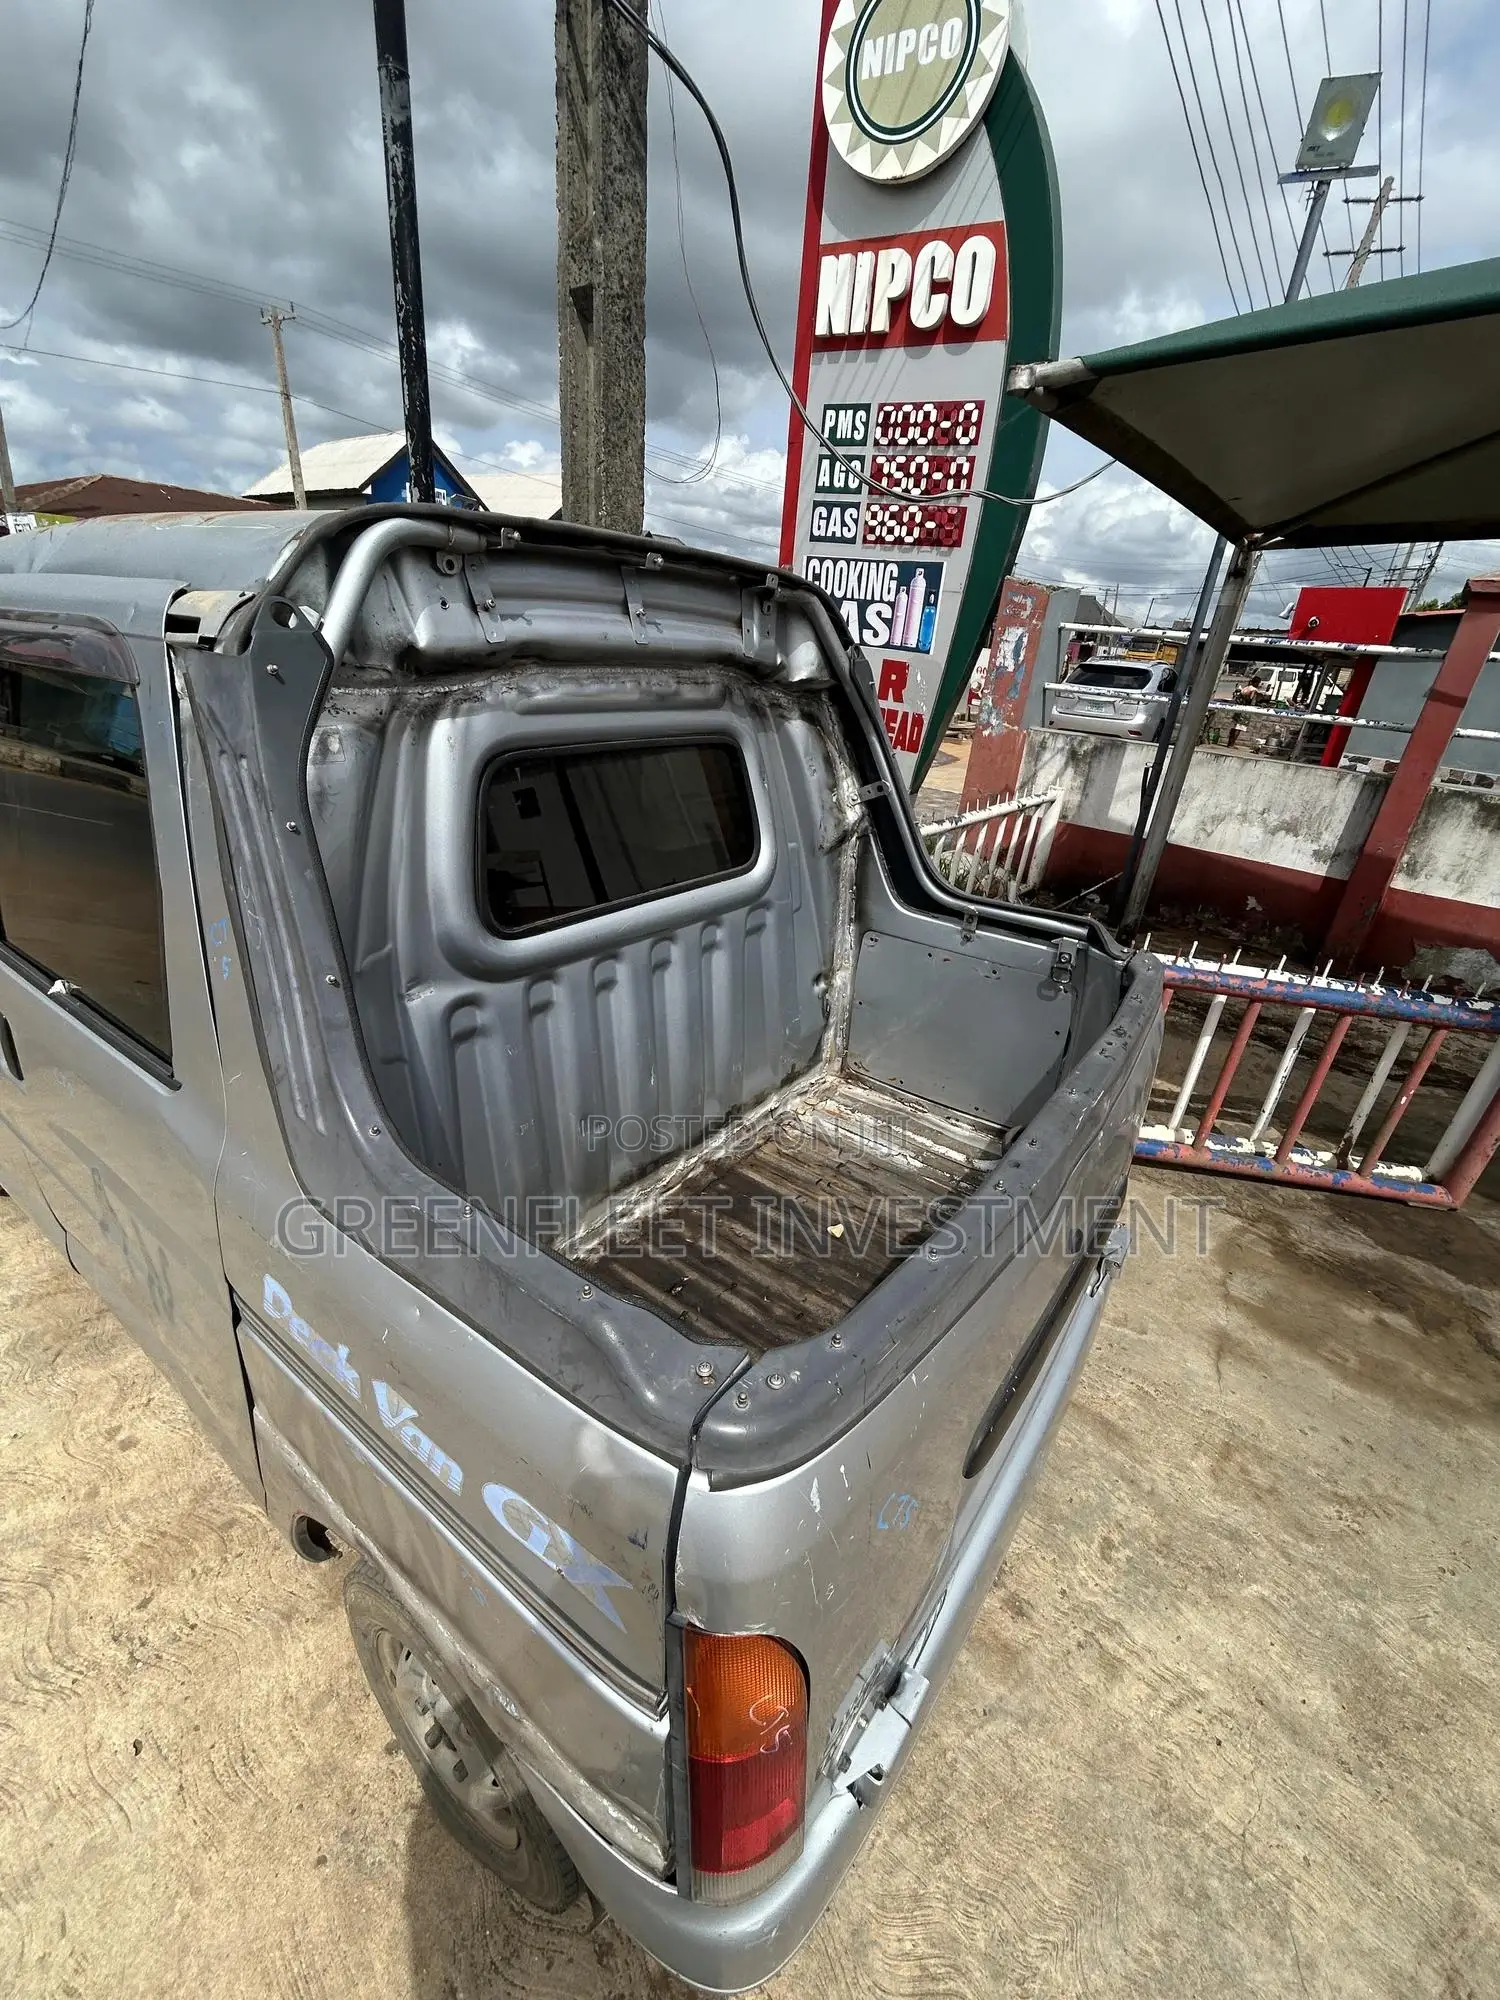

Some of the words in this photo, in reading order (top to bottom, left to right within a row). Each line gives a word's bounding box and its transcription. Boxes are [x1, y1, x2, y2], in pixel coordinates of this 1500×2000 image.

[860, 17, 963, 80] NIPCO
[815, 235, 996, 337] NIPCO
[823, 409, 867, 441] PMS
[818, 459, 862, 489] AGO
[812, 506, 858, 539] GAS
[807, 558, 899, 602] COOKING
[840, 600, 893, 646] AS
[880, 707, 924, 753] EAD
[371, 1379, 464, 1496] Van
